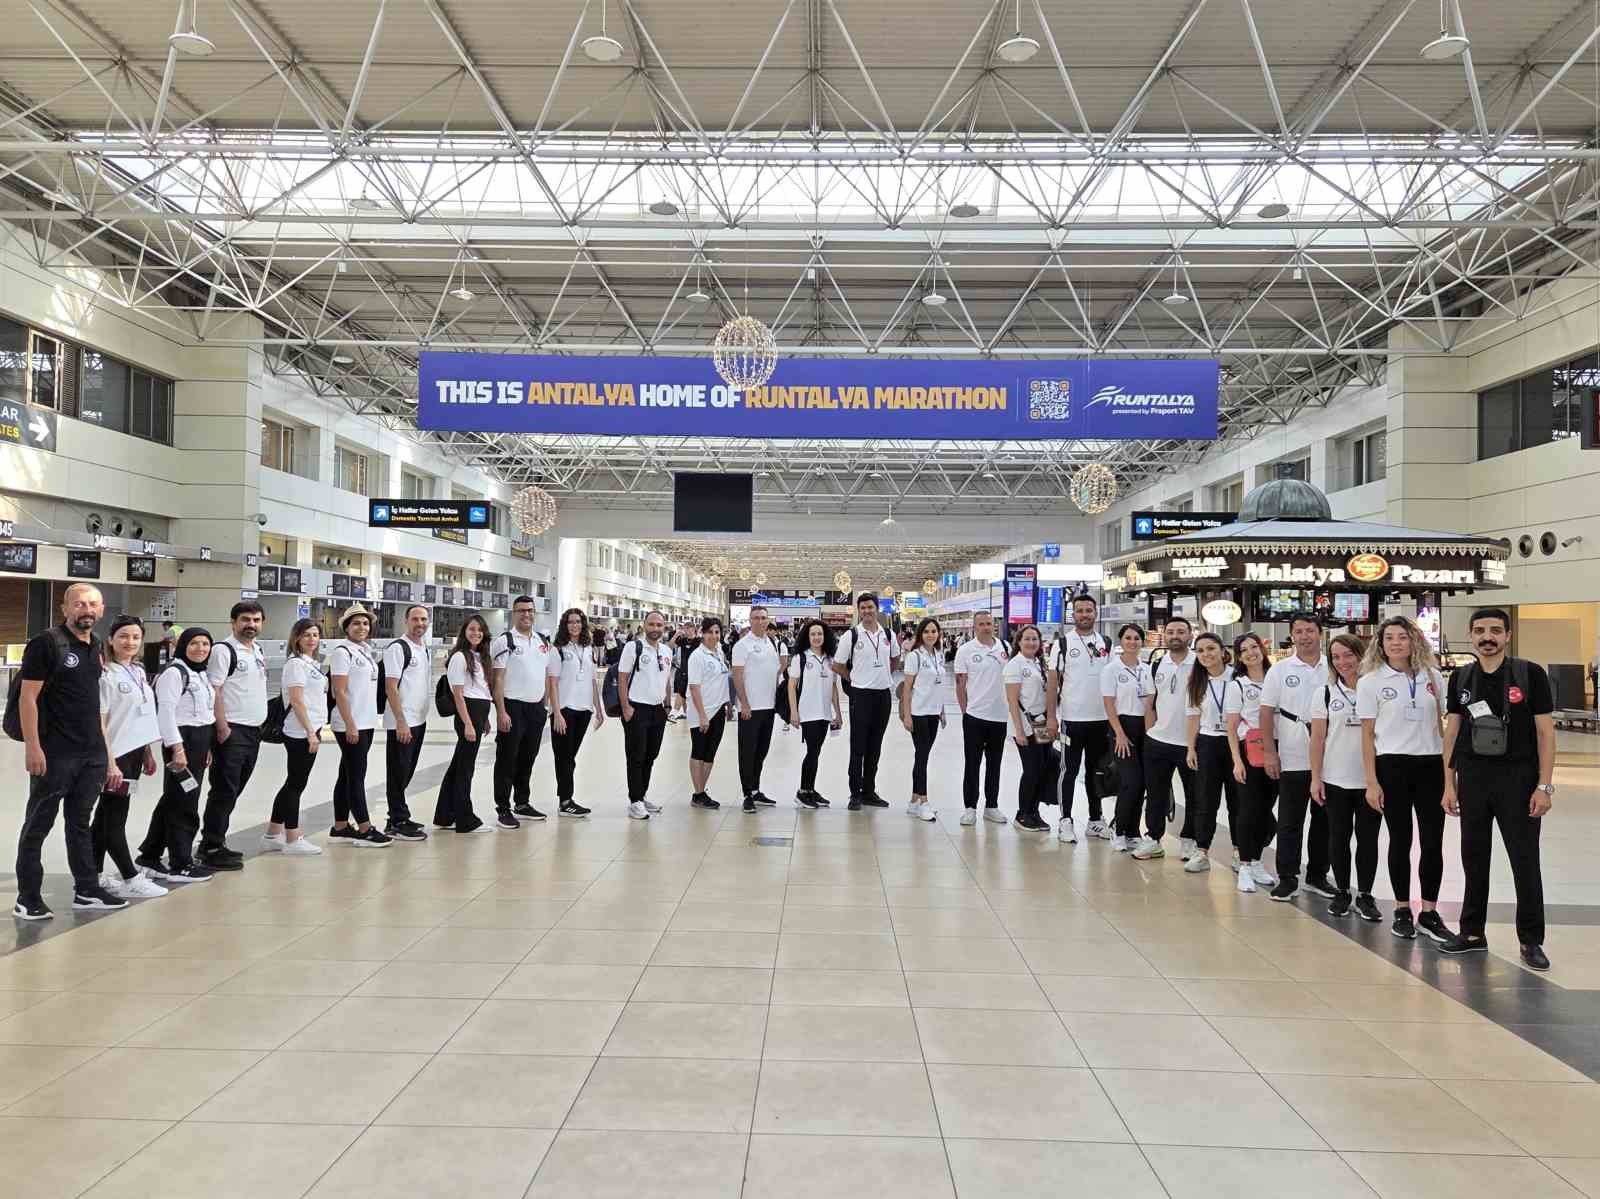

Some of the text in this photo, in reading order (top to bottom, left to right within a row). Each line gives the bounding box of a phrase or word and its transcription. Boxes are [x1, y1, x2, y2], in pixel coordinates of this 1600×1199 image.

[436, 380, 1007, 410] THIS IS ANTALYA HOME OF RUNTALYA MARATHON
[1112, 394, 1195, 406] RUNTALYA
[0, 406, 18, 421] AR
[1142, 408, 1149, 416] by
[1150, 407, 1177, 415] Fraport
[0, 521, 13, 536] 345
[144, 541, 155, 553] 347
[1172, 557, 1228, 568] BAKLAVA
[1244, 562, 1345, 586] Malatya
[1391, 564, 1475, 583] Pazarı
